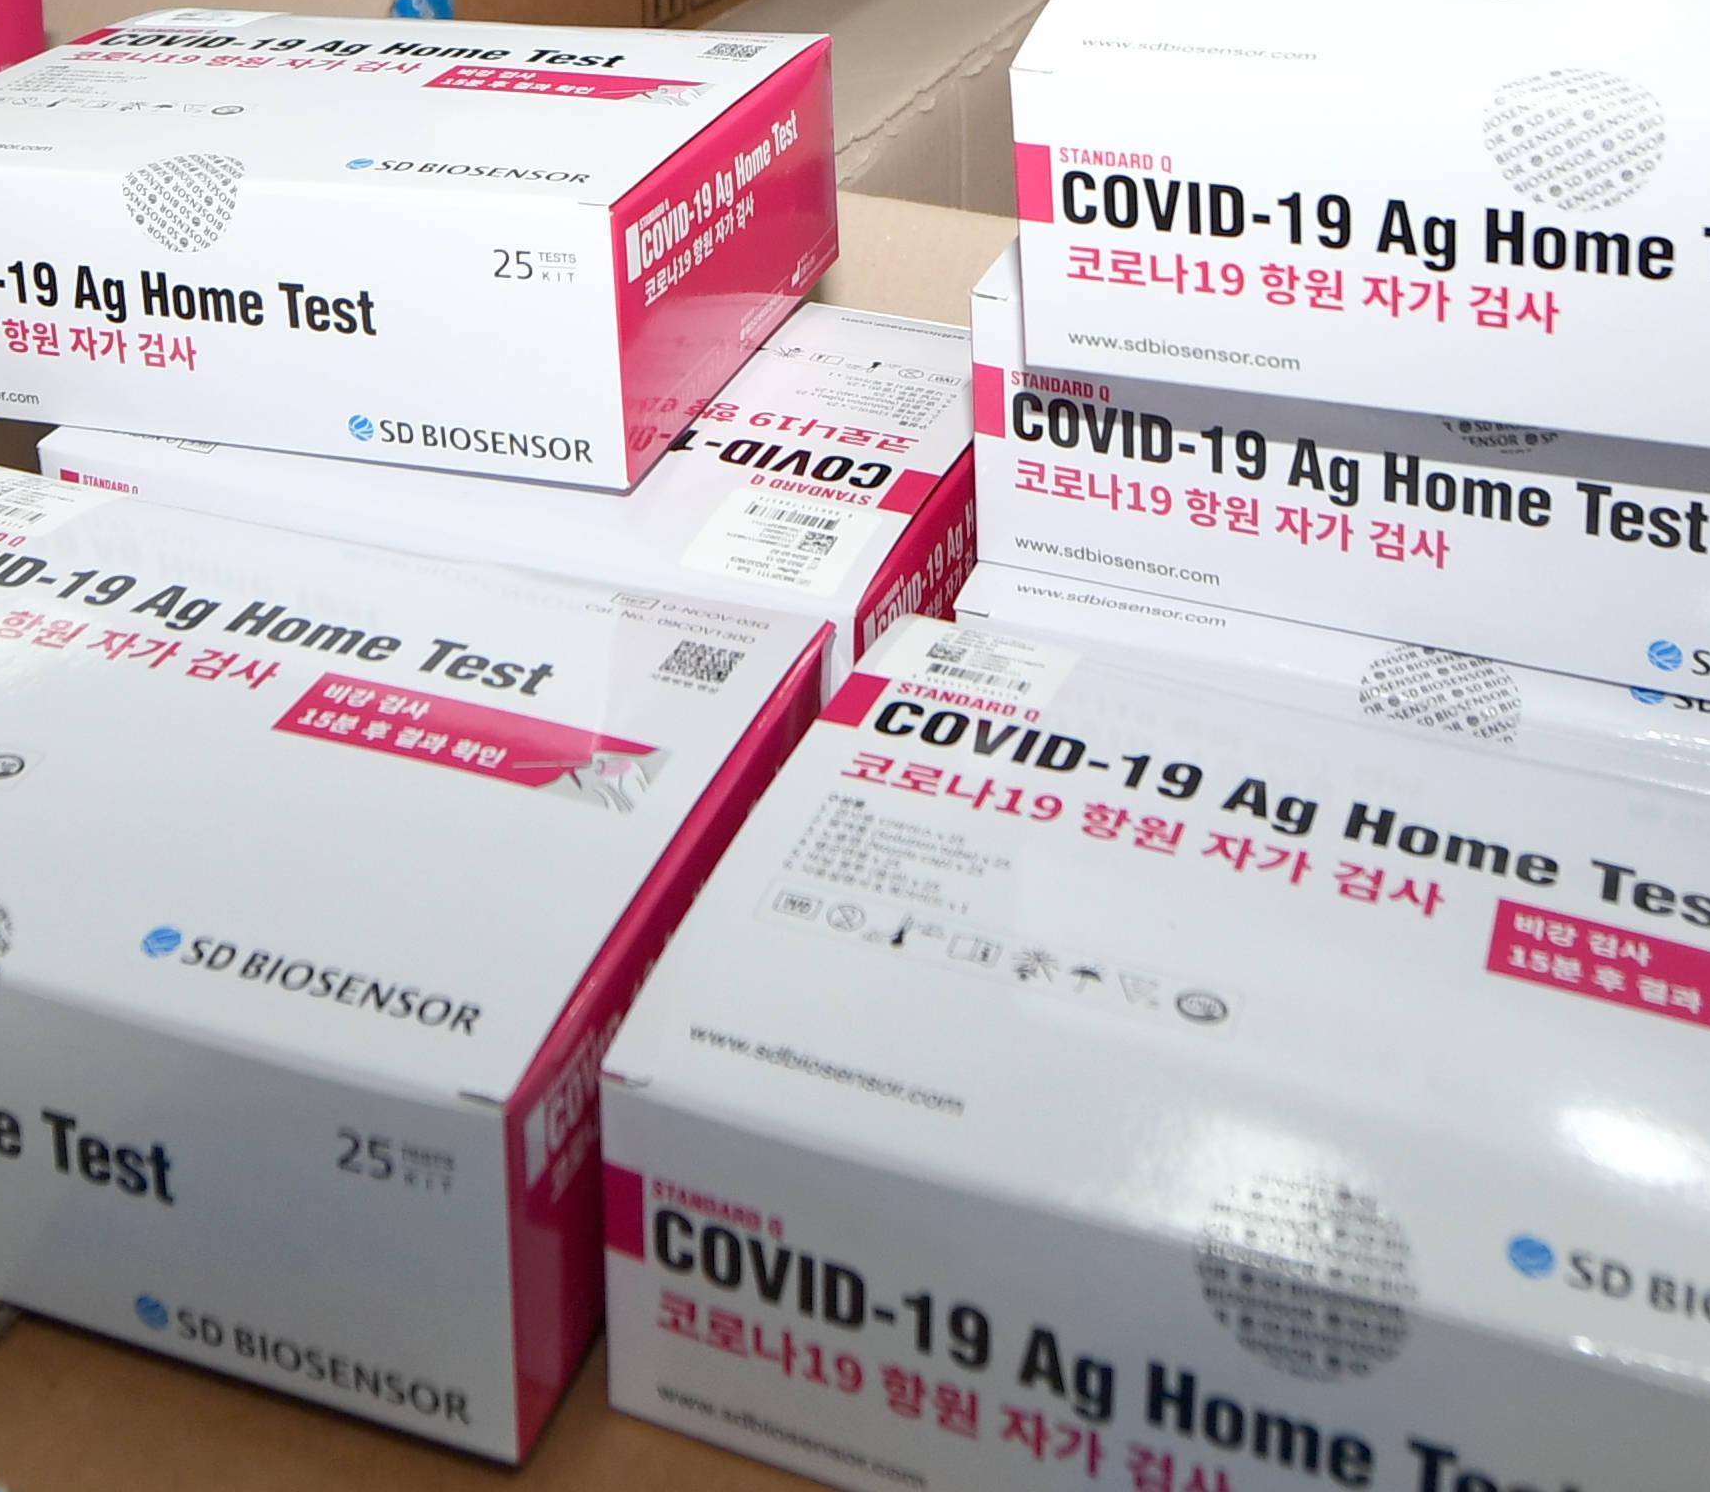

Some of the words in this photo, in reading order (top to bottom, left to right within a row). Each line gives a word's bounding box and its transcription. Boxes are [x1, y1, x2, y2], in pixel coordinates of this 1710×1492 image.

[62, 51, 201, 68] 코로나19
[98, 33, 307, 53] COVID-19
[306, 40, 373, 58] Ag
[379, 41, 511, 62] Home
[524, 49, 626, 69] Test
[374, 158, 414, 171] SD
[418, 161, 591, 184] BIOSENSOR
[713, 171, 735, 217] Ag
[772, 108, 799, 157] Test
[1059, 147, 1154, 171] STANDARD
[1061, 170, 1352, 250] COVID-19
[1376, 198, 1457, 274] Ag
[1484, 208, 1675, 281] Home
[538, 251, 577, 265] TESTS
[74, 264, 127, 325] Ag
[139, 269, 265, 328] Home
[277, 281, 378, 336] Test
[1067, 245, 1246, 297] 코로나19
[1259, 262, 1346, 312] 항원
[1362, 274, 1452, 324] 자가
[1469, 284, 1561, 335] 검사
[1, 318, 61, 357] 항원
[68, 326, 127, 365] 자가
[137, 331, 197, 372] 검사
[1068, 332, 1301, 371] www.sdbiosensor.com
[1011, 370, 1094, 400] STANDARD
[380, 418, 414, 445] SD
[422, 422, 594, 464] BIOSENSOR
[668, 429, 892, 489] COVID-1
[748, 410, 920, 455] 코로나19
[82, 474, 129, 493] STANDARD
[769, 477, 873, 506] STANDARD
[1012, 391, 1267, 482] COVID-19
[1286, 437, 1360, 508] Ag
[1383, 450, 1552, 529] Home
[1576, 481, 1709, 555] Test
[947, 522, 963, 567] Ag
[1015, 459, 1173, 517] 코로나19
[1184, 487, 1260, 537] 항원
[1274, 504, 1354, 553] 자가
[1369, 519, 1451, 570] 검사
[1014, 535, 1221, 587] www.sdbiosensor.com
[131, 585, 222, 631] Ag
[224, 599, 402, 663] Home
[418, 638, 556, 697] Test
[323, 684, 376, 707] 비강
[379, 694, 432, 721] 검사
[296, 708, 361, 739] 15분
[450, 738, 508, 769] 확인
[873, 701, 1203, 800] COVID-19
[1221, 776, 1319, 836] Ag
[1344, 801, 1559, 889] Home
[840, 752, 1064, 823] 코로나19
[1202, 829, 1314, 887] 자가
[1334, 860, 1447, 918] 검사
[240, 950, 483, 1037] BIOSENSOR
[40, 1107, 176, 1207] Test
[653, 1207, 992, 1374] COVID-19
[1018, 1325, 1115, 1423] Ag
[1144, 1358, 1375, 1490] Home
[656, 1288, 868, 1395] 코로나19
[234, 1325, 472, 1426] BIOSENSOR
